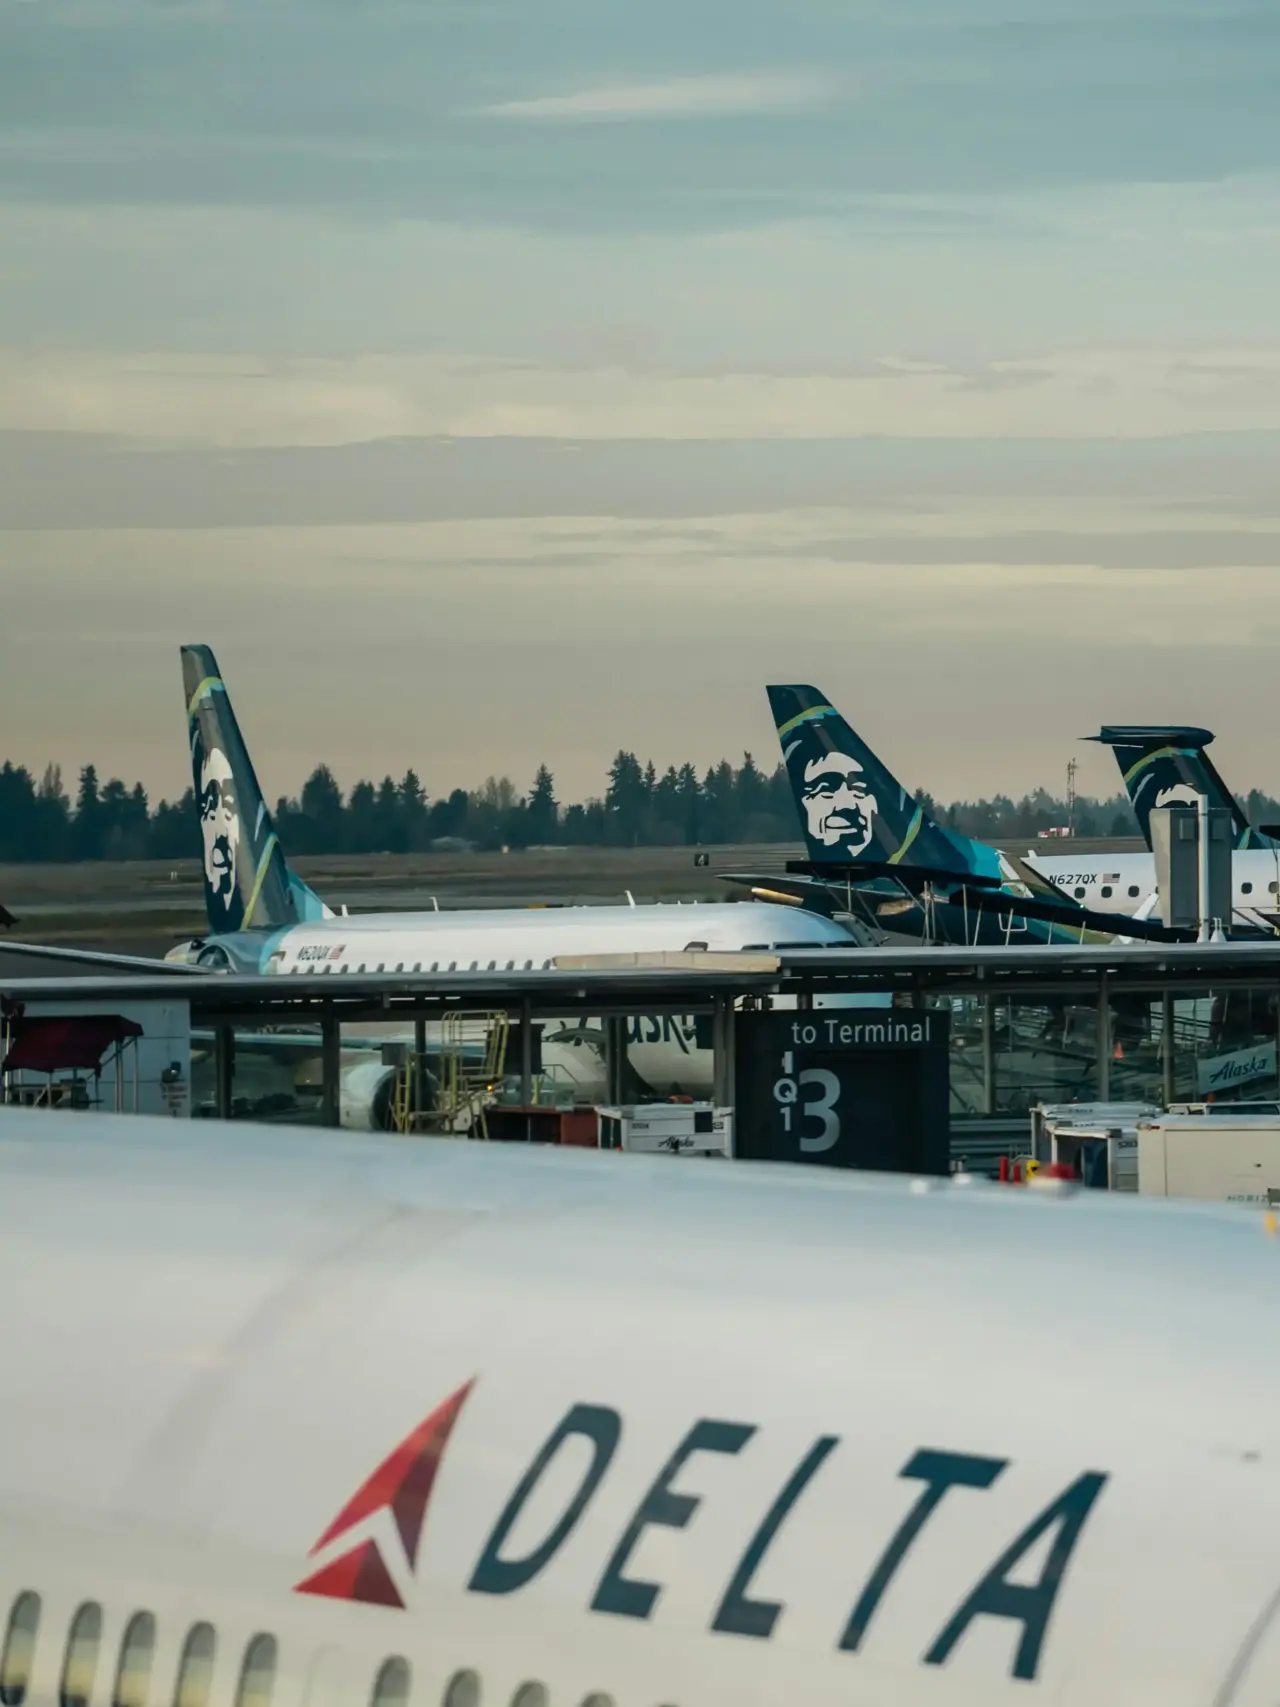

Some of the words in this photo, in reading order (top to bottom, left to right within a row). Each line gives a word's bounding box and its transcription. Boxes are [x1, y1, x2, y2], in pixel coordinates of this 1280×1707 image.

[1049, 873, 1098, 884] N627QX
[791, 1022, 817, 1044] to
[824, 1016, 931, 1043] Terminal
[1209, 1055, 1268, 1083] Alaska
[799, 1068, 841, 1153] 3
[467, 1403, 1110, 1681] DELTA
